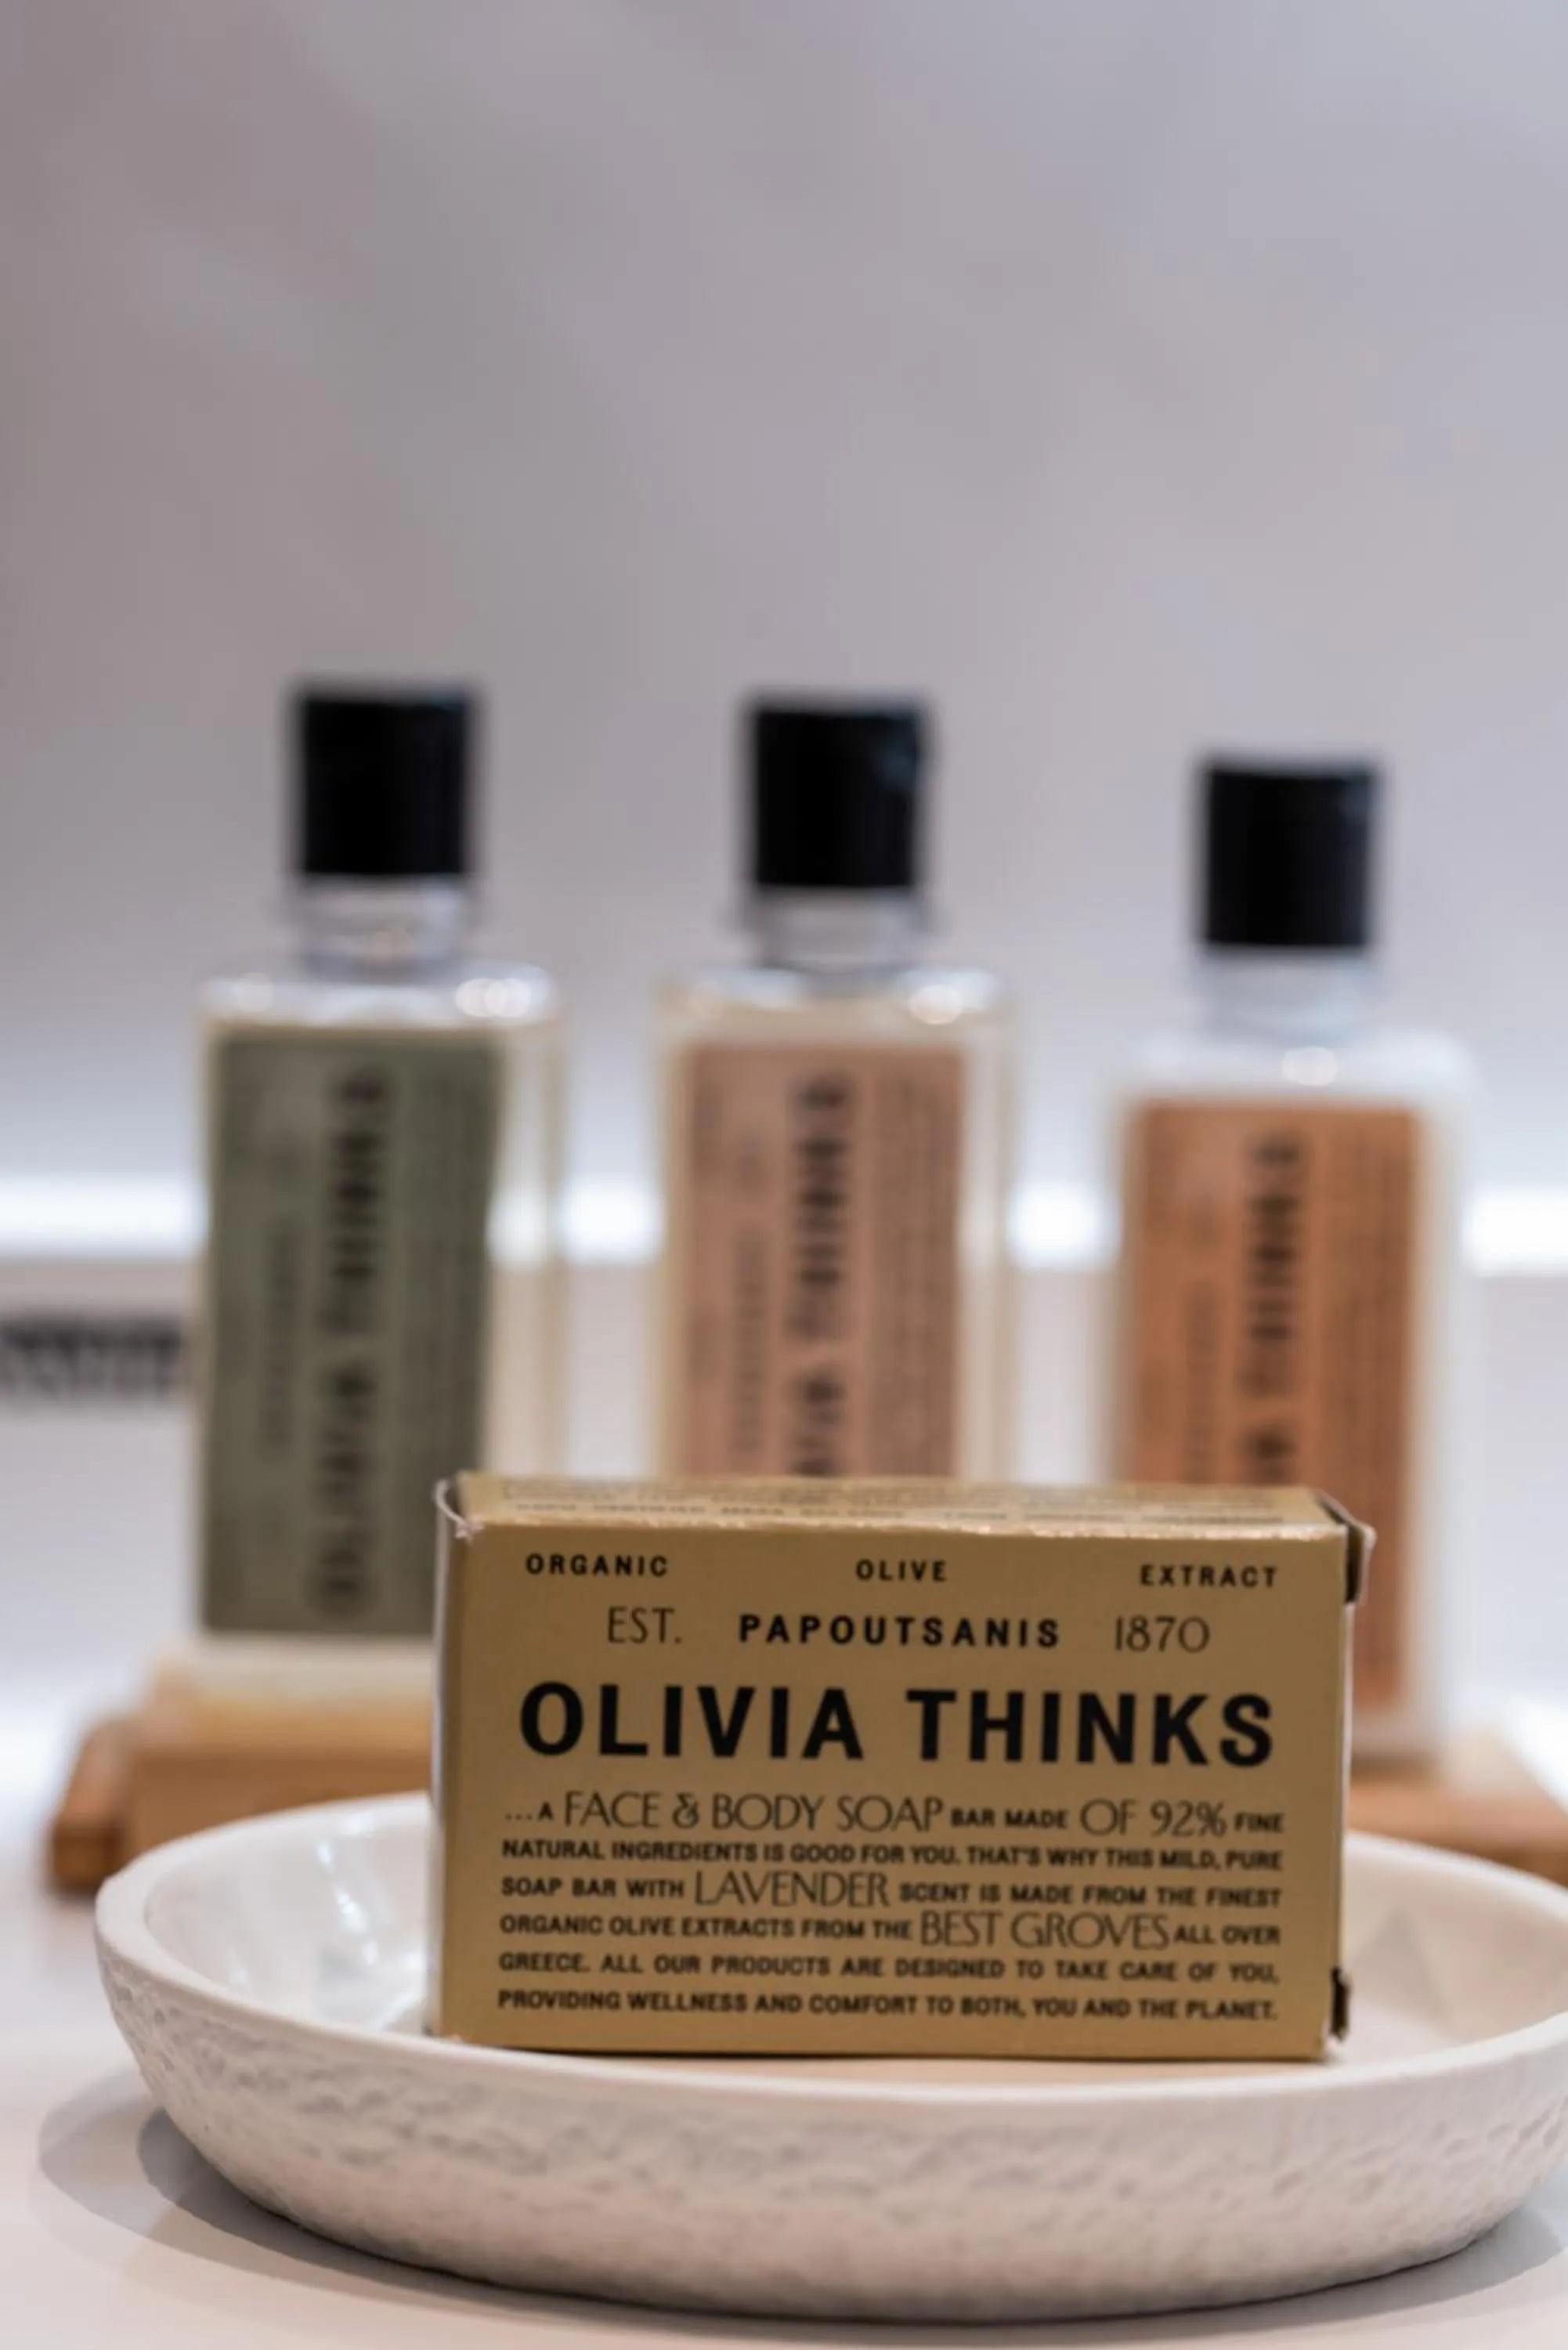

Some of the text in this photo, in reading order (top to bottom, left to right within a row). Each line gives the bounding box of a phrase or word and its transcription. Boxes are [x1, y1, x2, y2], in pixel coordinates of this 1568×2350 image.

[525, 1553, 1277, 1589] ORGANIC OLIVE EXTRACT
[607, 1606, 1211, 1654] EST. PAPOUTSANIS 1870
[519, 1680, 1273, 1769] OLIVIA THINKS
[565, 1791, 660, 1828] FACE
[671, 1792, 699, 1829] &
[712, 1792, 824, 1831] BODY
[837, 1795, 944, 1832] SOAP
[951, 1808, 995, 1827] BAR
[1005, 1810, 1067, 1828] MADE
[1079, 1799, 1136, 1835] OF
[1150, 1800, 1227, 1837] 92%
[1234, 1813, 1283, 1833] FINE
[502, 1839, 605, 1860] NATURAL
[611, 1841, 757, 1862] INGREDIENTS
[763, 1842, 785, 1863] IS
[789, 1842, 856, 1864] GOOD
[861, 1844, 905, 1864] FOR
[966, 1846, 1041, 1867] THAT'S
[1046, 1848, 1099, 1866] WHY
[1105, 1847, 1154, 1868] THIS
[1159, 1849, 1220, 1870] MILD,
[1225, 1850, 1281, 1871] PURE
[501, 1870, 1282, 1908] SOAP BAR WITH LAVENDER SCENT IS MADE FROM THE FINEST
[500, 1910, 1280, 1950] ORGANIC OLIVE EXTRACTS FROM THE BEST GROVES ALL OVER
[499, 1952, 590, 1972] GREECE.
[600, 1954, 643, 1974] ALL
[653, 1954, 701, 1974] OUR
[711, 1954, 830, 1976] PRODUCTS
[840, 1958, 883, 1977] ARE
[895, 1958, 1006, 1979] DESIGNED
[1016, 1959, 1045, 1979] TO
[1056, 1960, 1107, 1980] TAKE
[1119, 1961, 1176, 1981] CARE
[1187, 1961, 1218, 1983] OF
[498, 1990, 1277, 2020] PROVIDING WELLNESS AND COMFORT TO BOTH, YOU AND THE PLANET.
